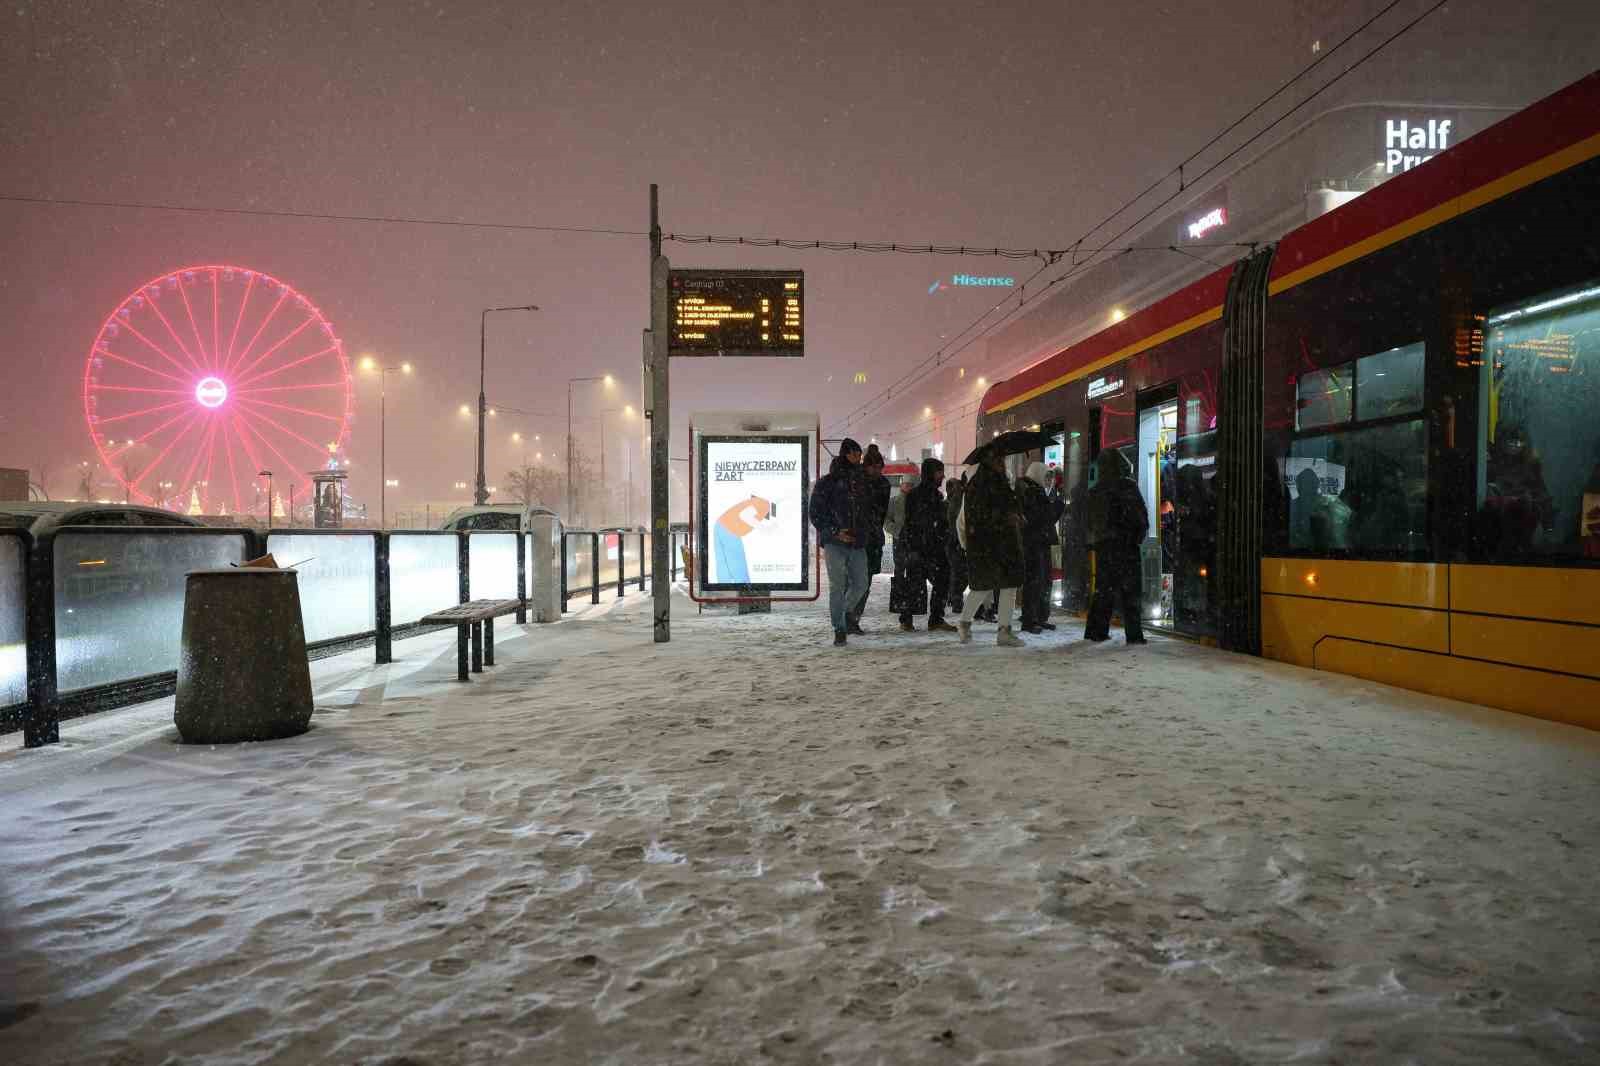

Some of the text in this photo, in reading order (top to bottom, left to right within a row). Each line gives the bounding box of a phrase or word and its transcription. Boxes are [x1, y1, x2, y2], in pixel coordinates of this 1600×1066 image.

[1386, 119, 1451, 149] Half
[952, 275, 1015, 287] Hisense
[714, 461, 797, 471] NIEWYCZERPANY
